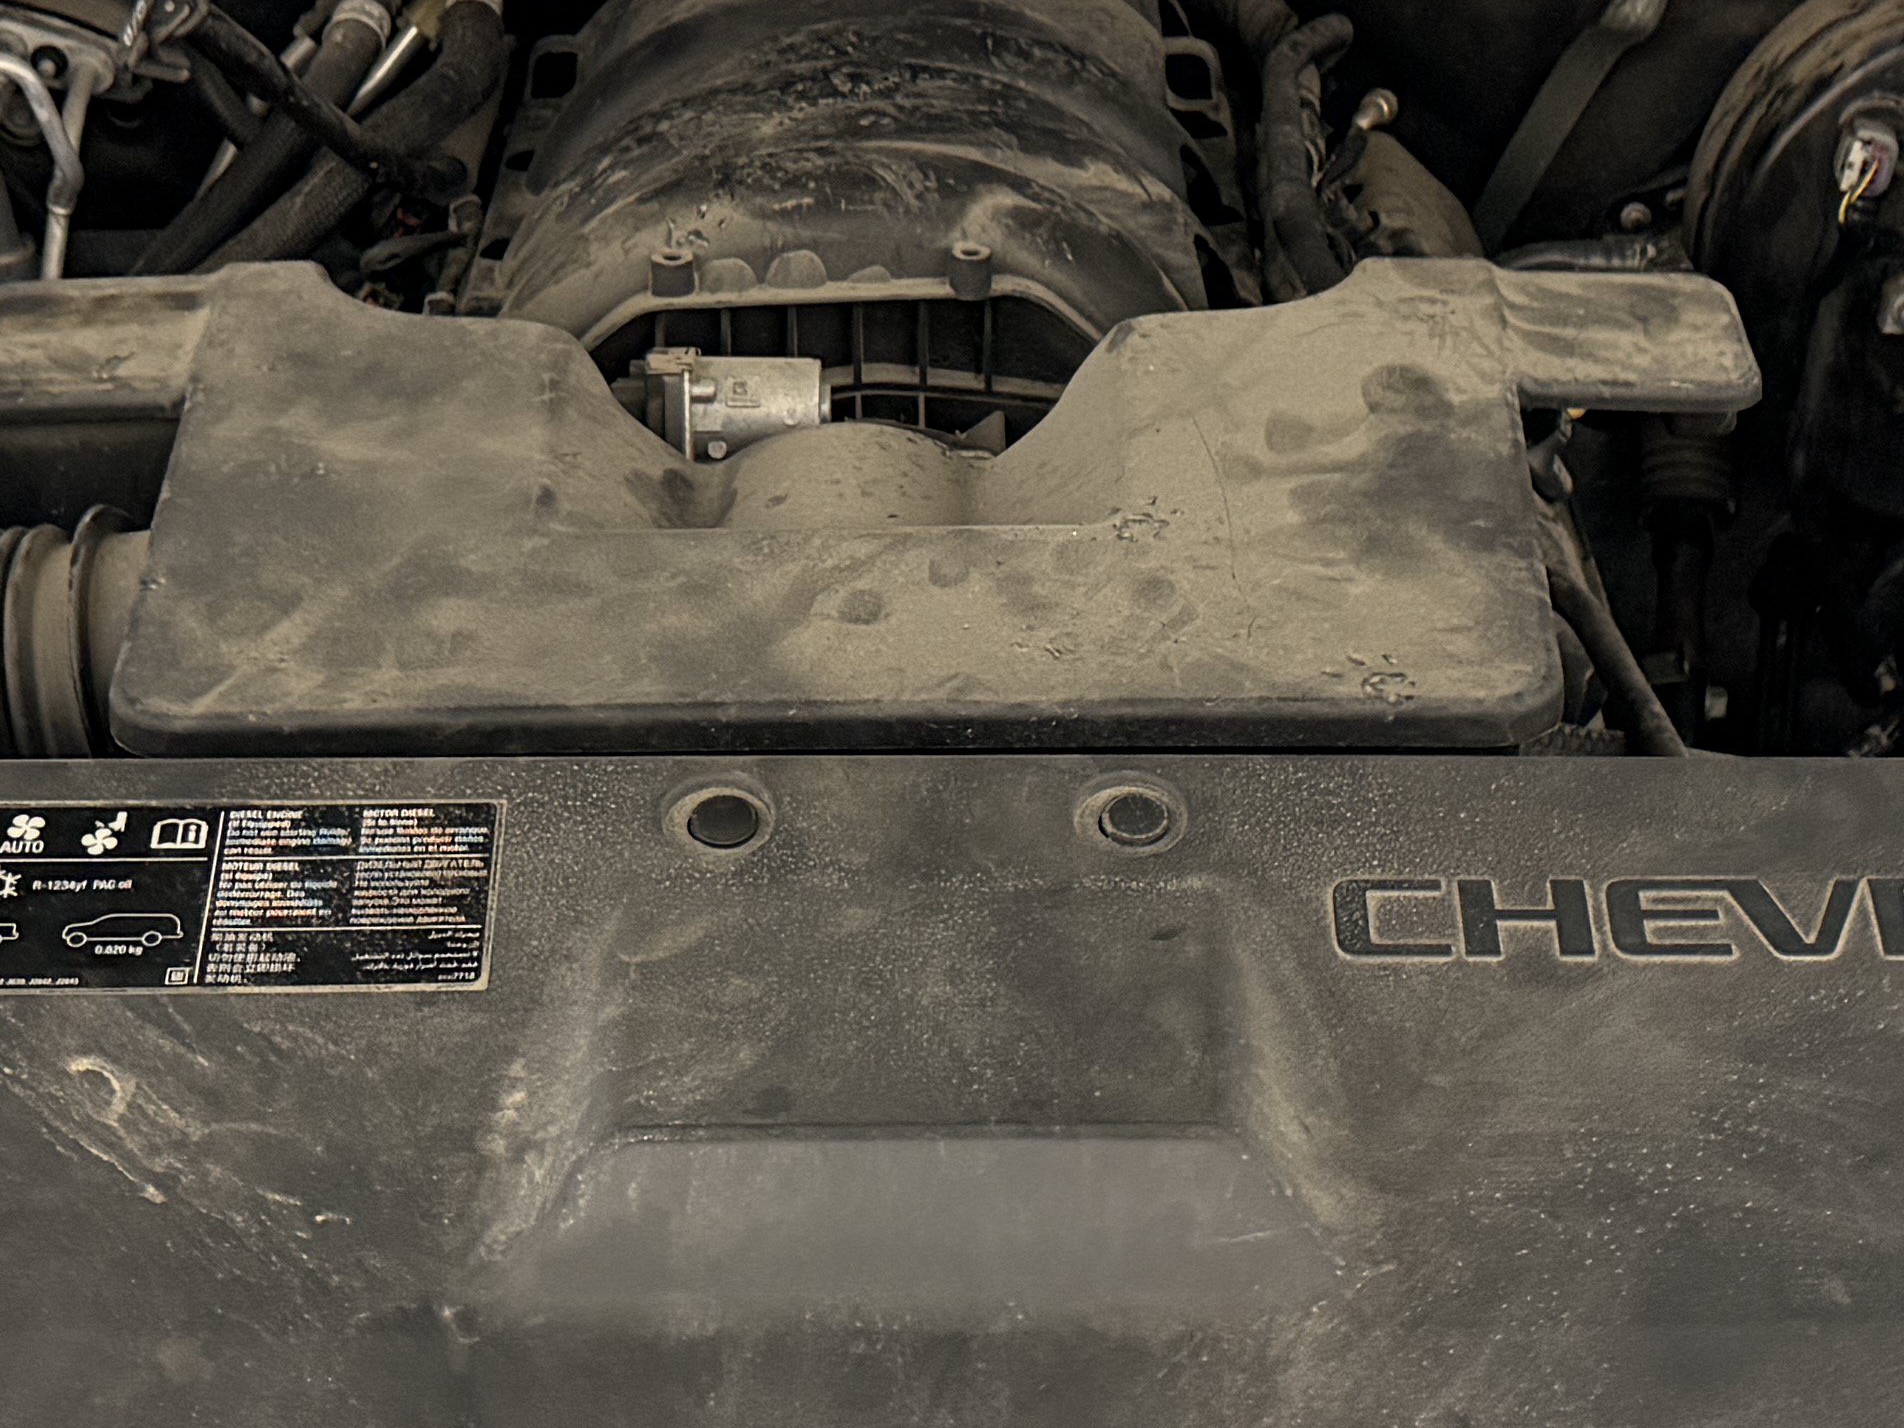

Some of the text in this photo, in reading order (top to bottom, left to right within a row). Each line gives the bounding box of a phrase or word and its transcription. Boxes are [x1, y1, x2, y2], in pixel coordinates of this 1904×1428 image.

[0, 840, 45, 854] AUTO
[32, 879, 88, 892] R-1234yf
[128, 944, 144, 957] kg
